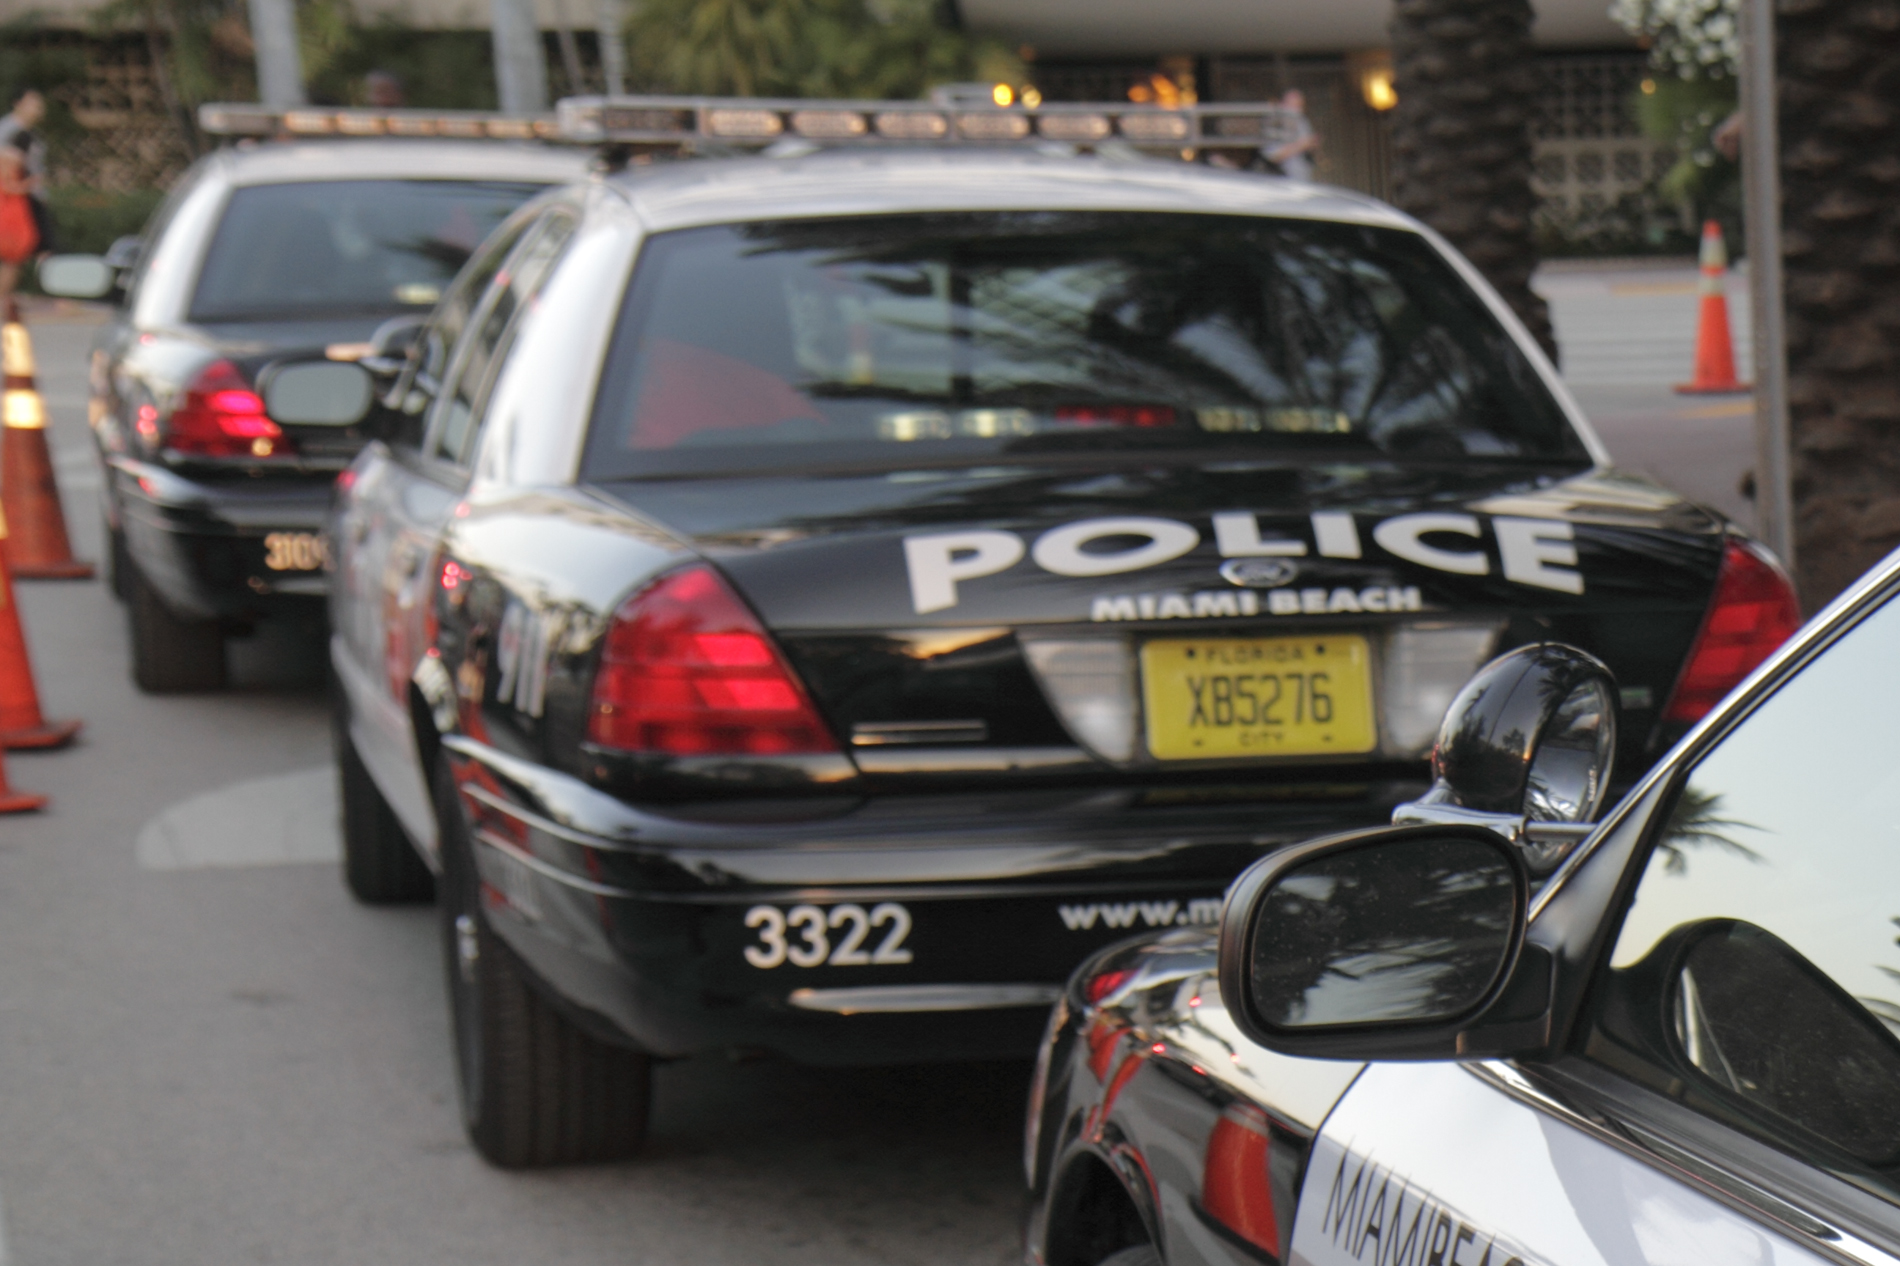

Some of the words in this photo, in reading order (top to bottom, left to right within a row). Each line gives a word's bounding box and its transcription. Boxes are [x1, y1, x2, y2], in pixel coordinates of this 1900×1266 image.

[903, 511, 1585, 614] POLICE
[1091, 590, 1259, 622] MIAMI
[1267, 585, 1423, 615] BEACH
[1186, 671, 1334, 728] XB5276
[743, 902, 915, 970] 3322
